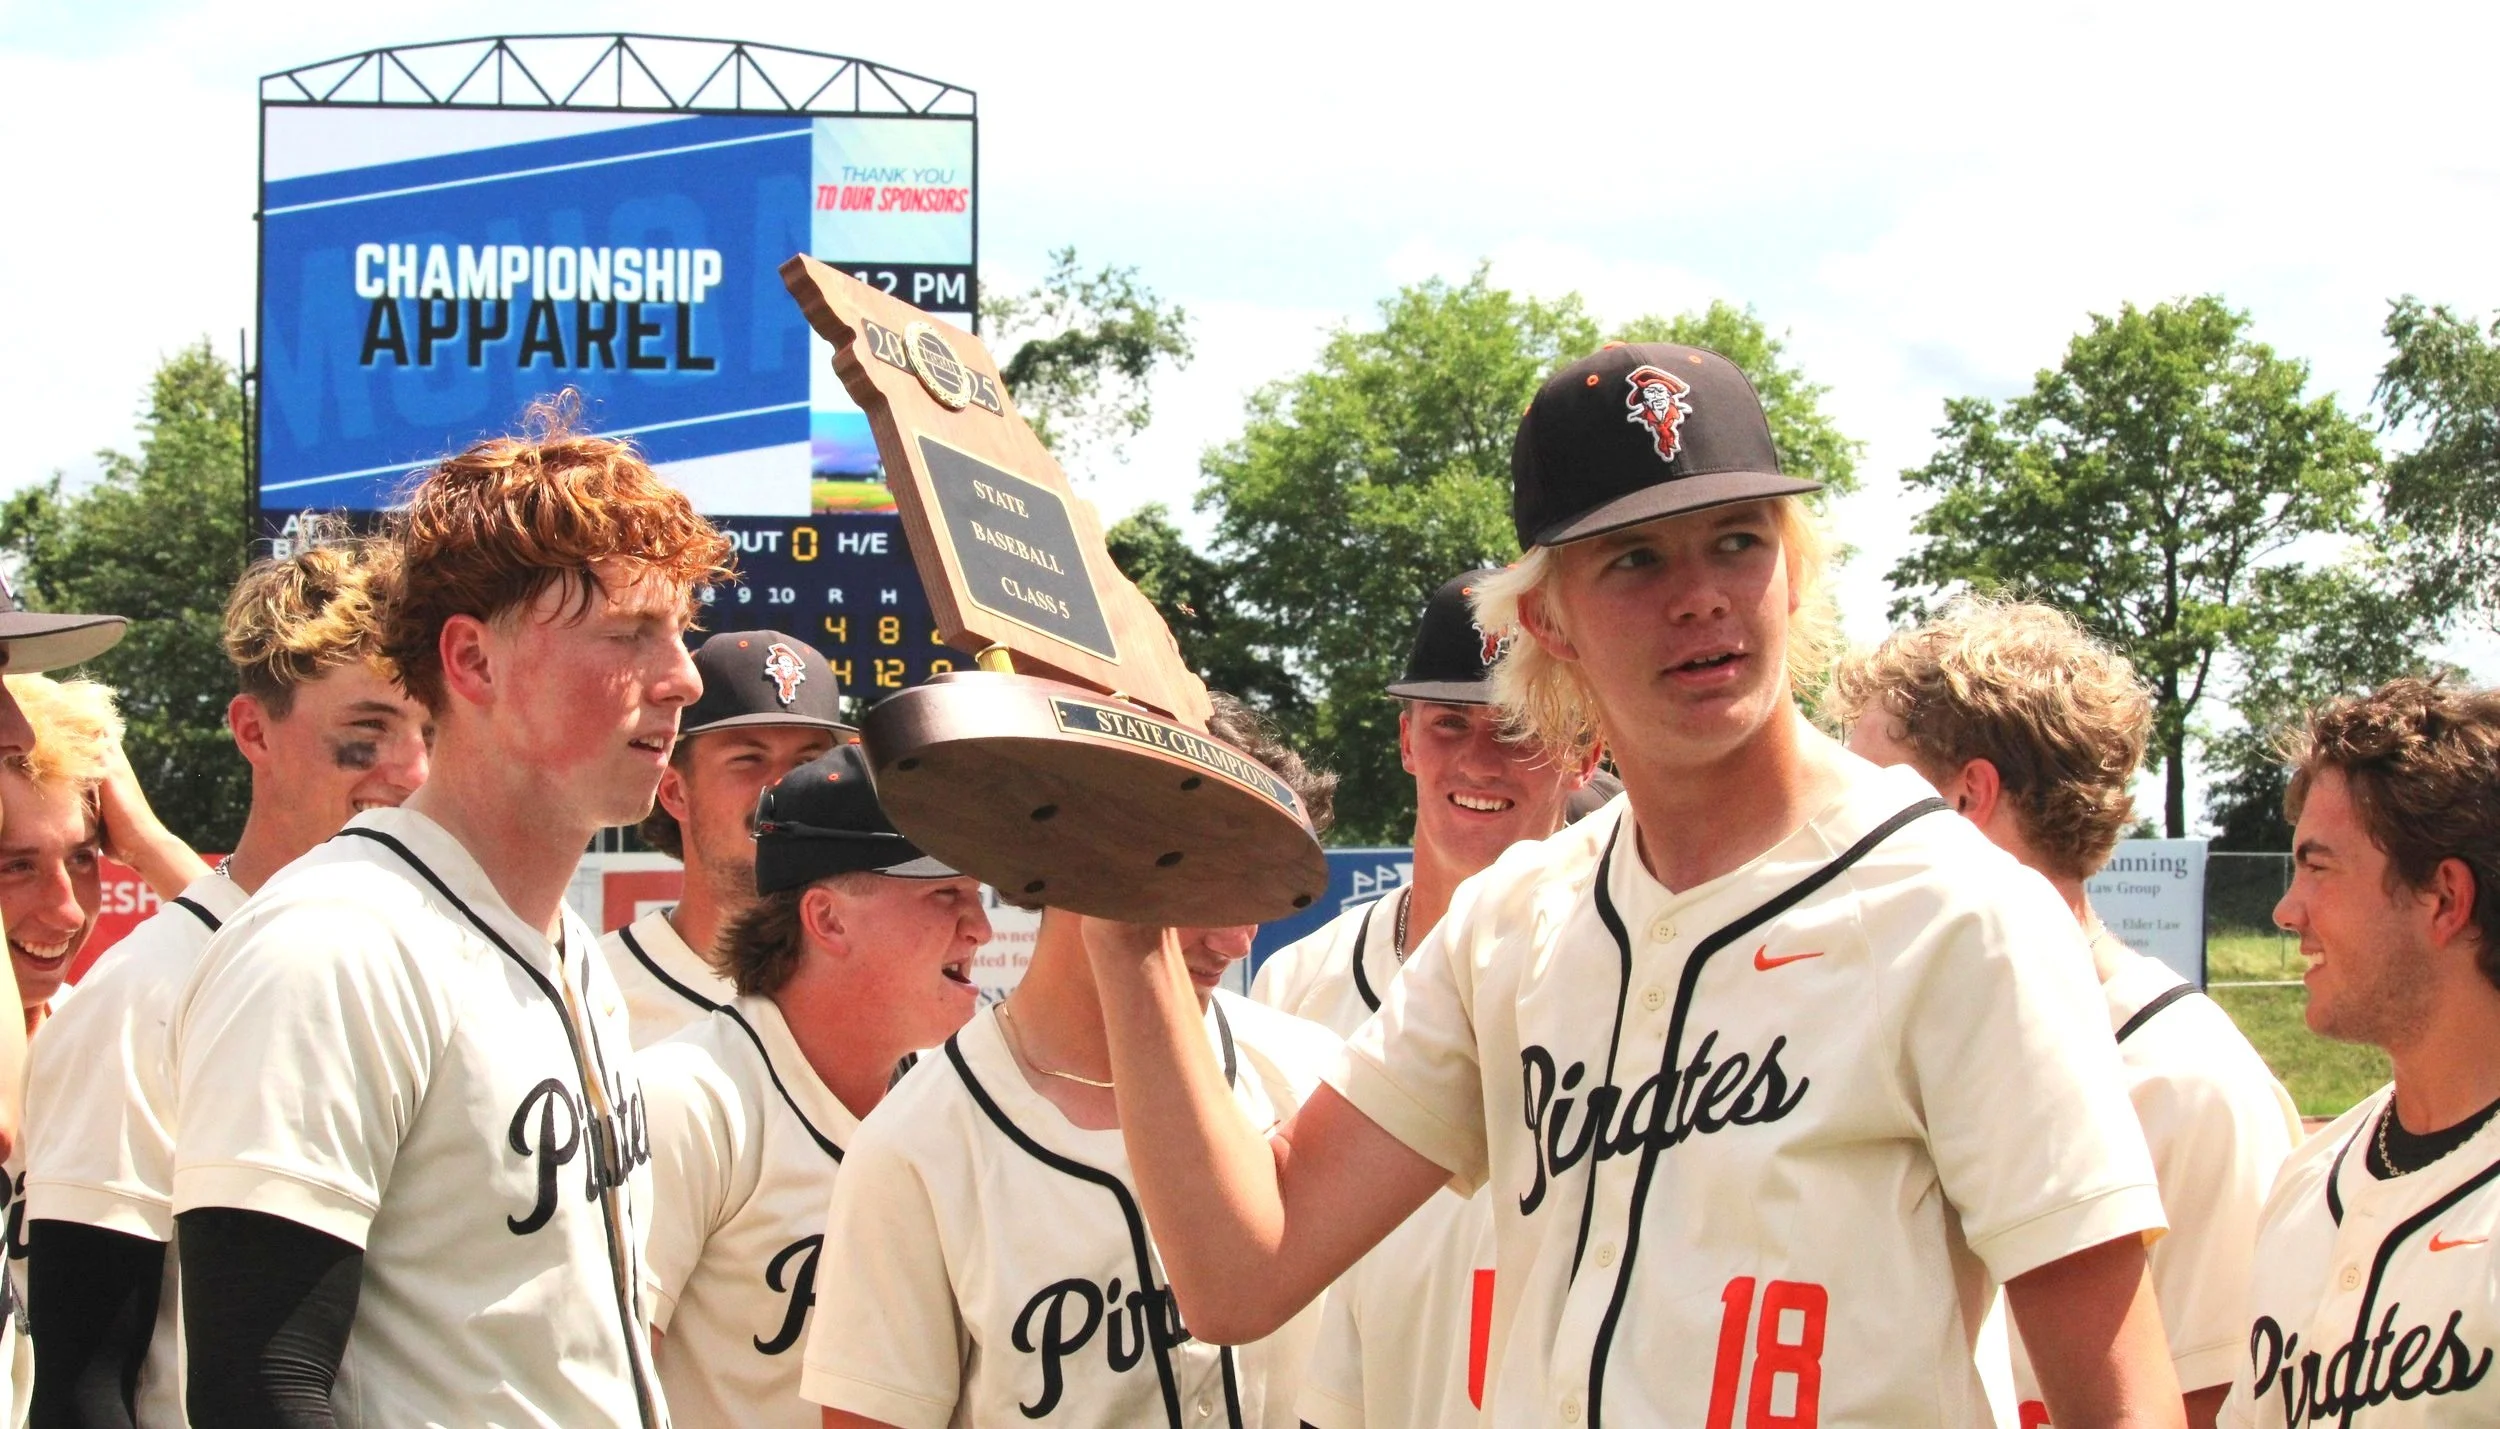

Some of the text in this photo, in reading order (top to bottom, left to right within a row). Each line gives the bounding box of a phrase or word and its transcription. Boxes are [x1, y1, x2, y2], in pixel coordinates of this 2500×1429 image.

[842, 166, 955, 184] THANK YOU
[816, 185, 969, 213] TO OUR SPONSORS
[355, 243, 722, 303] CHAMPIONSHIP
[913, 272, 966, 304] PM
[358, 291, 717, 371] APPAREL
[973, 480, 1029, 519] STATE
[792, 527, 818, 562] 0
[837, 532, 888, 555] H/E
[970, 520, 1064, 576] BASEBALL
[738, 587, 752, 604] 9
[768, 587, 796, 604] 10
[828, 588, 844, 604] R
[880, 589, 898, 605] H
[1001, 577, 1070, 619] CLASS 5
[824, 616, 847, 643] 4
[878, 616, 900, 645] 8
[874, 659, 905, 688] 12
[1096, 710, 1278, 799] STATE CHAMPIONS
[2117, 881, 2161, 899] Group
[2157, 919, 2181, 931] Law
[1519, 1029, 1811, 1217] Pirates
[1704, 1276, 1829, 1429] 18
[2250, 1301, 2494, 1429] Pirates
